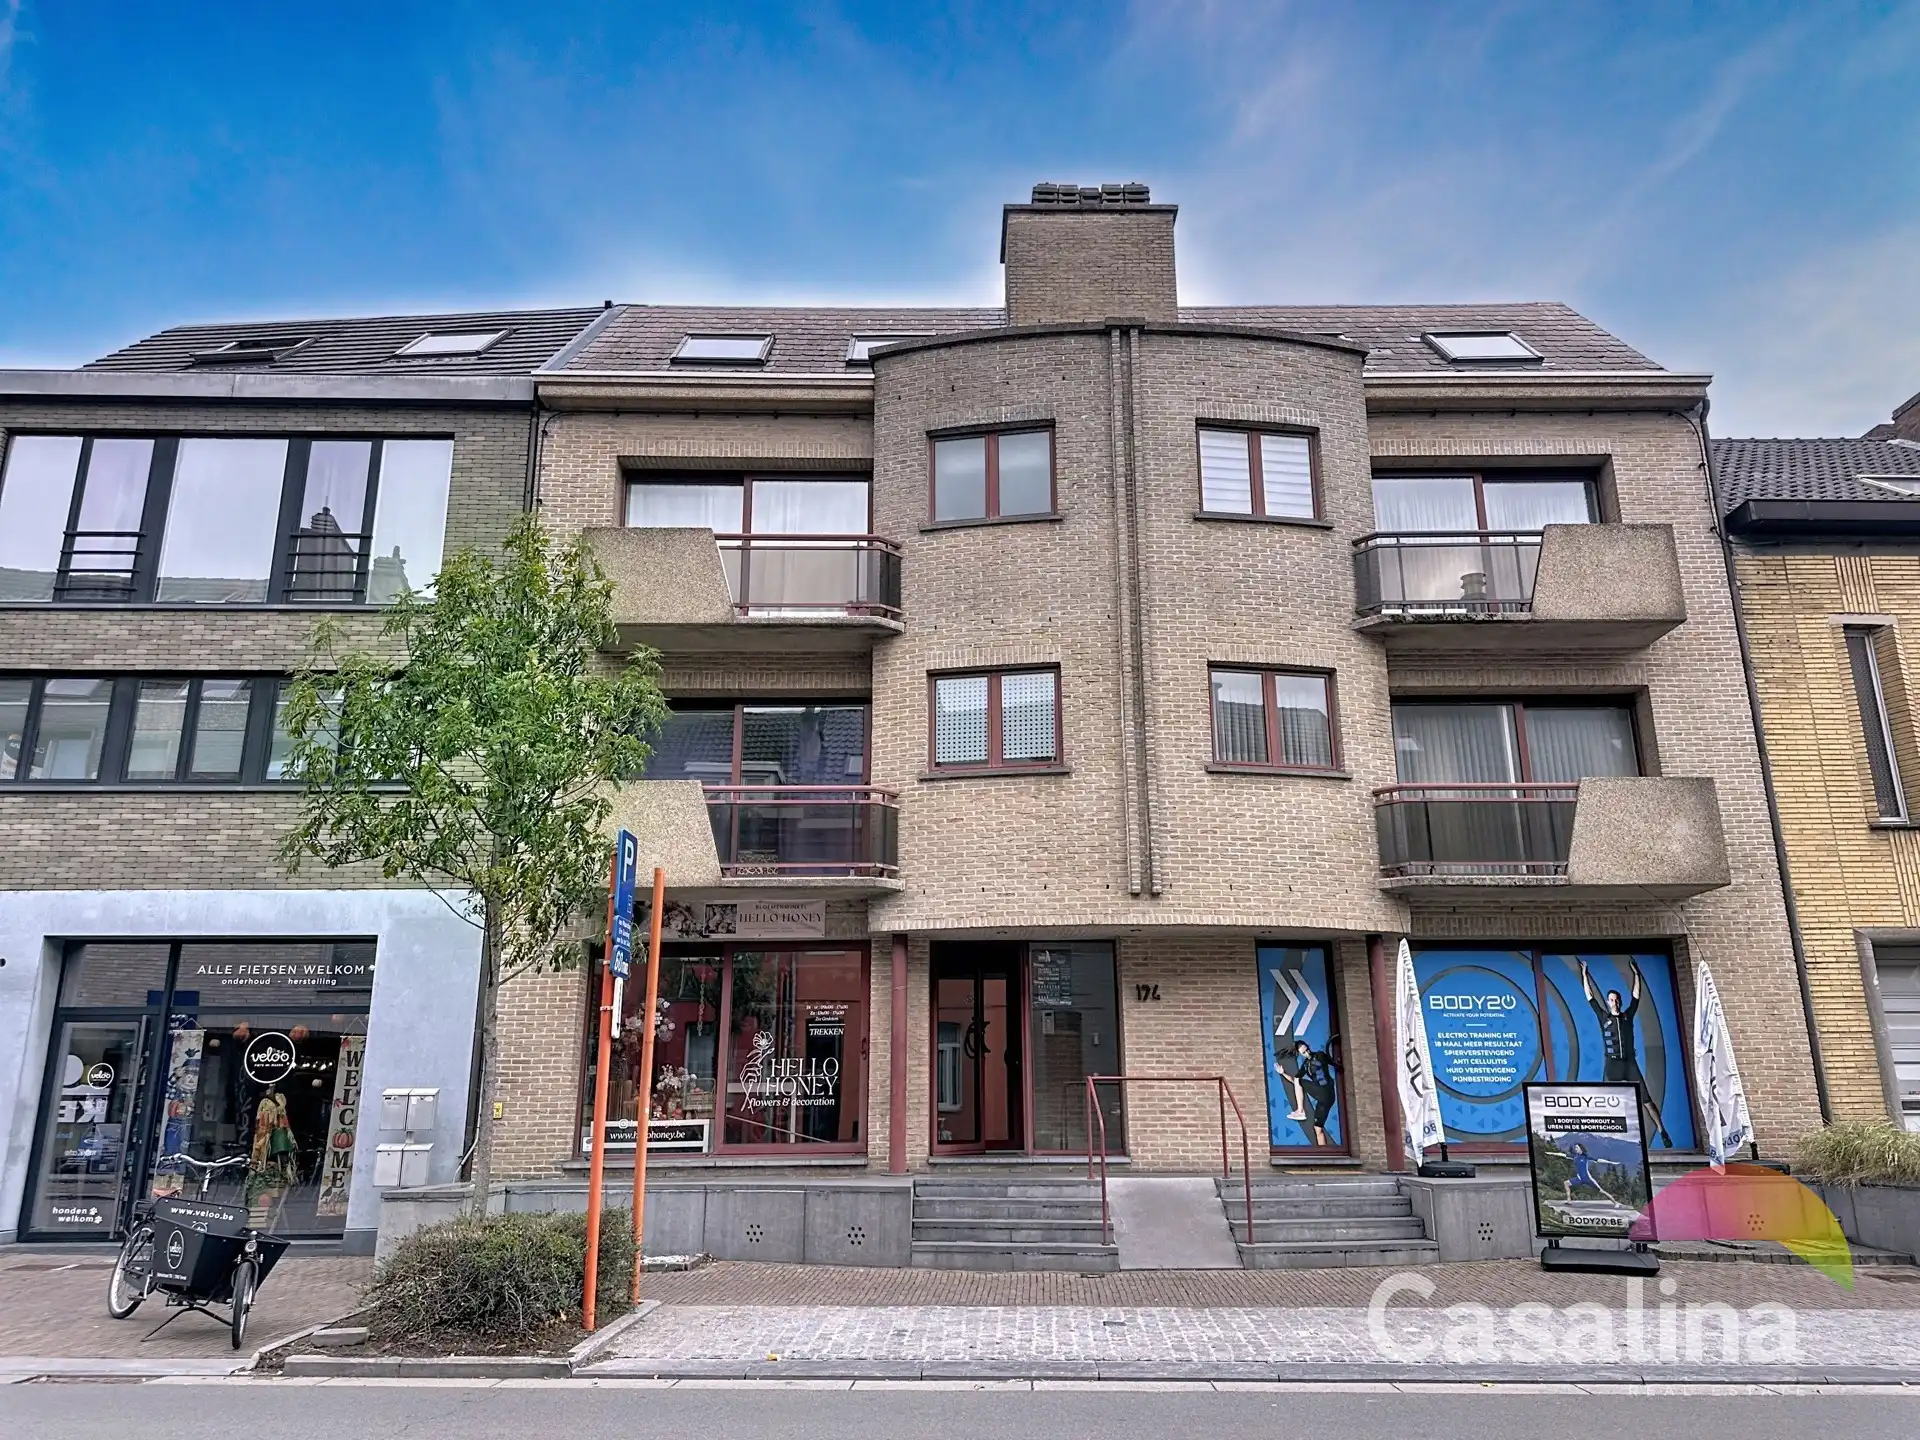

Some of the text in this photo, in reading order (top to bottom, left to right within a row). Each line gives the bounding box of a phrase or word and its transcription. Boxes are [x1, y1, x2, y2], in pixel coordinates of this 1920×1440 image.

[623, 838, 634, 882] P
[740, 913, 821, 923] HELLO HONEY
[197, 965, 364, 975] ALLE FIETSEN WELKOM
[288, 978, 337, 986] herstelling
[809, 1028, 844, 1036] TREKKEN
[250, 1046, 290, 1062] veloo
[771, 1057, 839, 1077] HELLO
[91, 1070, 111, 1079] veloo
[766, 1076, 838, 1096] HONEY
[750, 1096, 835, 1107] flowers & decoration
[171, 1207, 234, 1220] www.veloo.be
[1568, 1217, 1623, 1226] BODY20.BE
